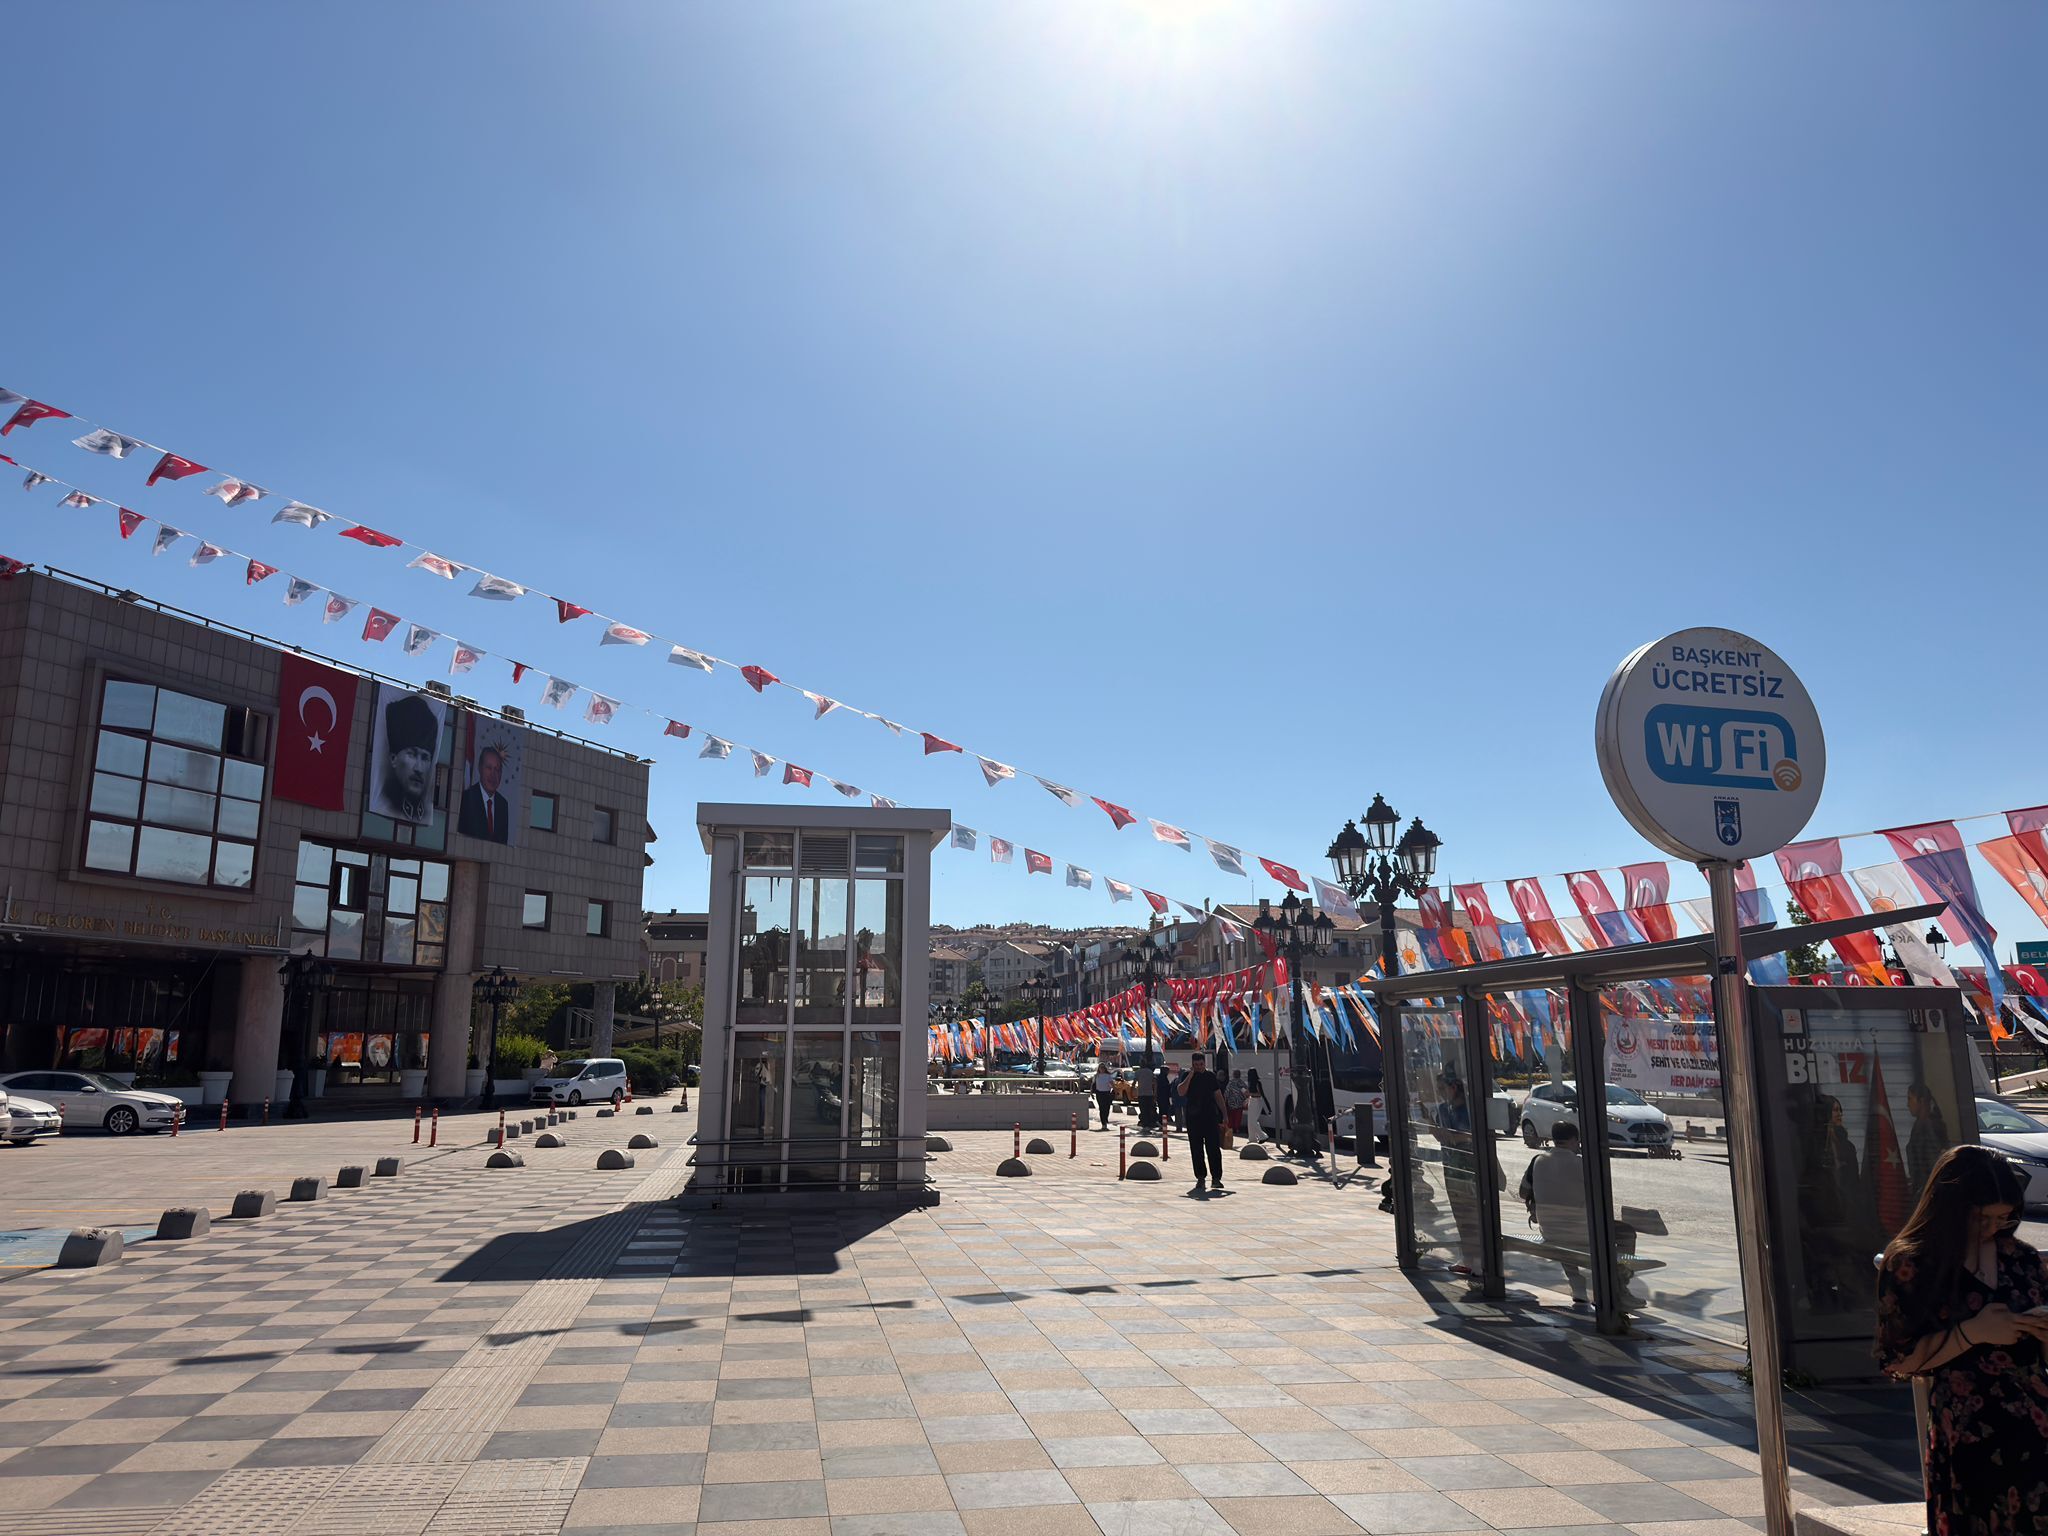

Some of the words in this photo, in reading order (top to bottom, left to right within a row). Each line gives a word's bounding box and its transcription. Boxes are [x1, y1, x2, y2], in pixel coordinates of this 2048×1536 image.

[1672, 646, 1762, 668] BAŞKENT
[1652, 662, 1785, 699] ÜCRETSİZ
[1646, 1038, 1669, 1051] MESUT
[1651, 1055, 1670, 1069] ŞEHİT
[1670, 1057, 1681, 1069] VE
[1681, 1056, 1720, 1071] GAZİLERİM
[1671, 1075, 1685, 1087] HER
